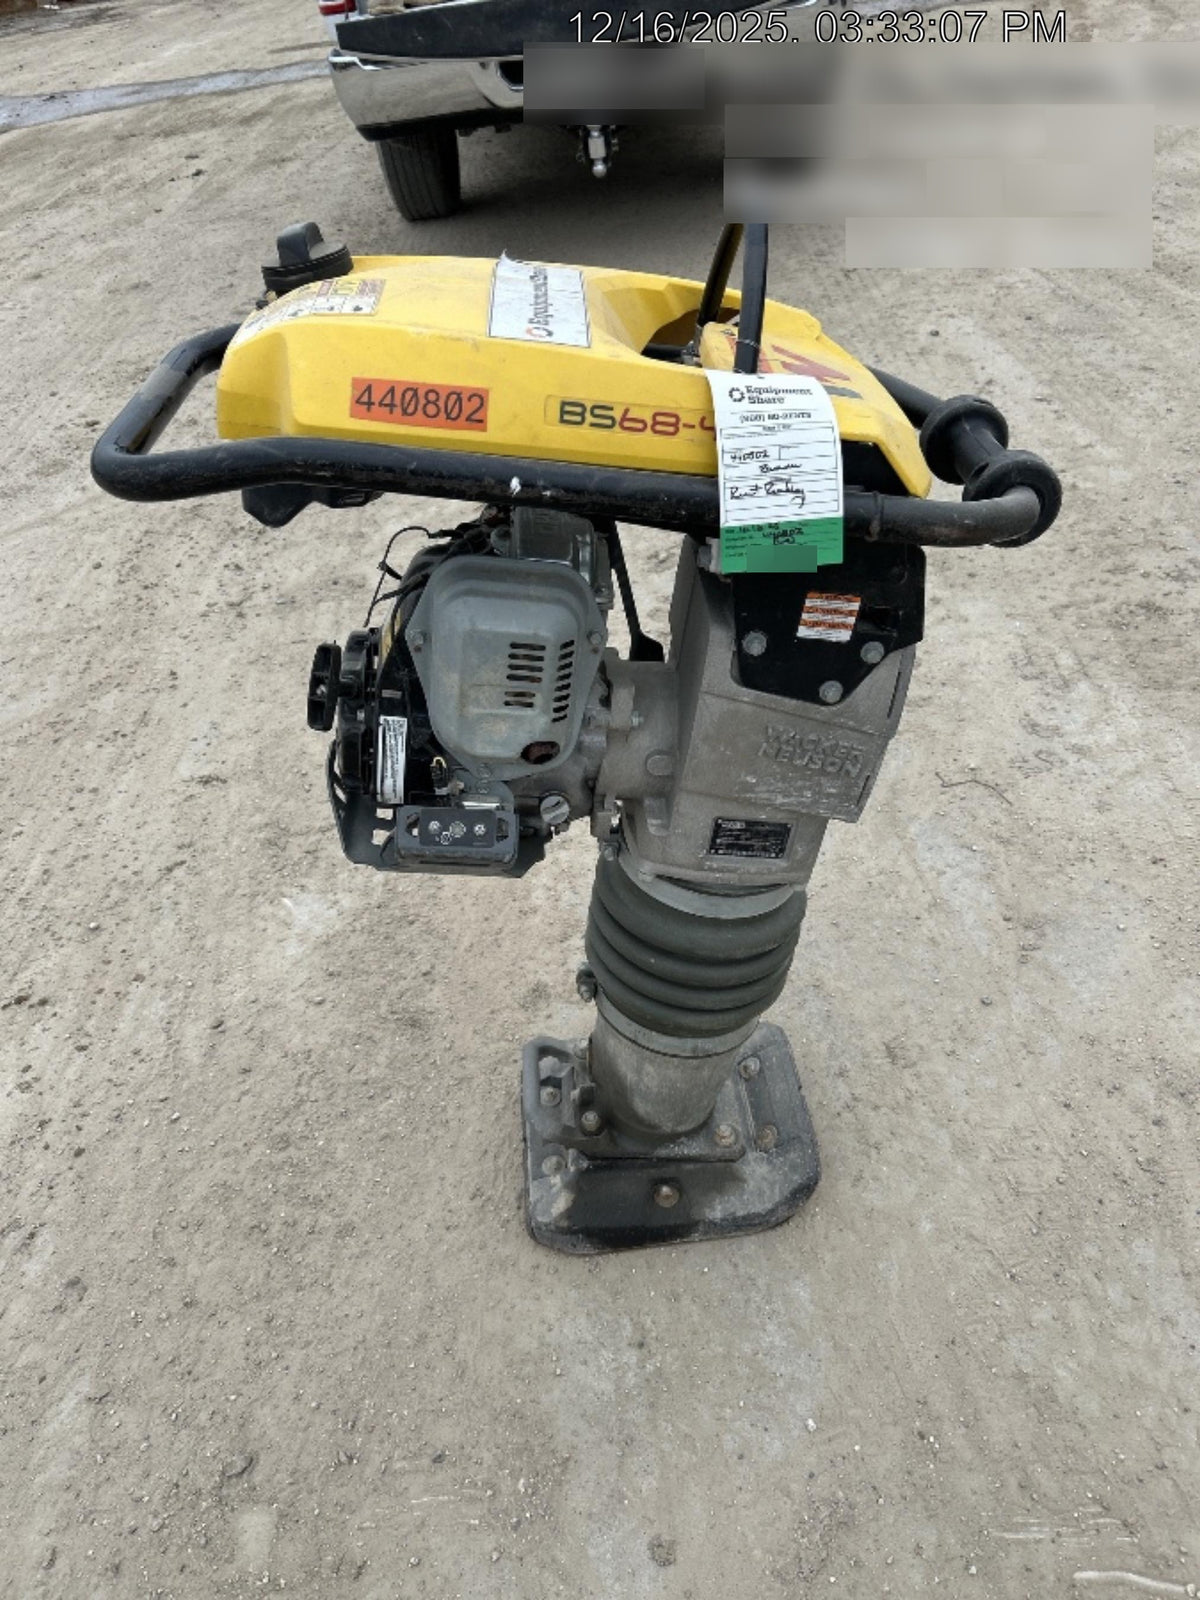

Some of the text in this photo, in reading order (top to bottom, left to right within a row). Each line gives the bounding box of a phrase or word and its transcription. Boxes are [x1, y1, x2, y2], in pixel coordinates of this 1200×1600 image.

[745, 385, 813, 396] Equipment
[355, 383, 485, 424] 440802
[747, 395, 785, 405] Share
